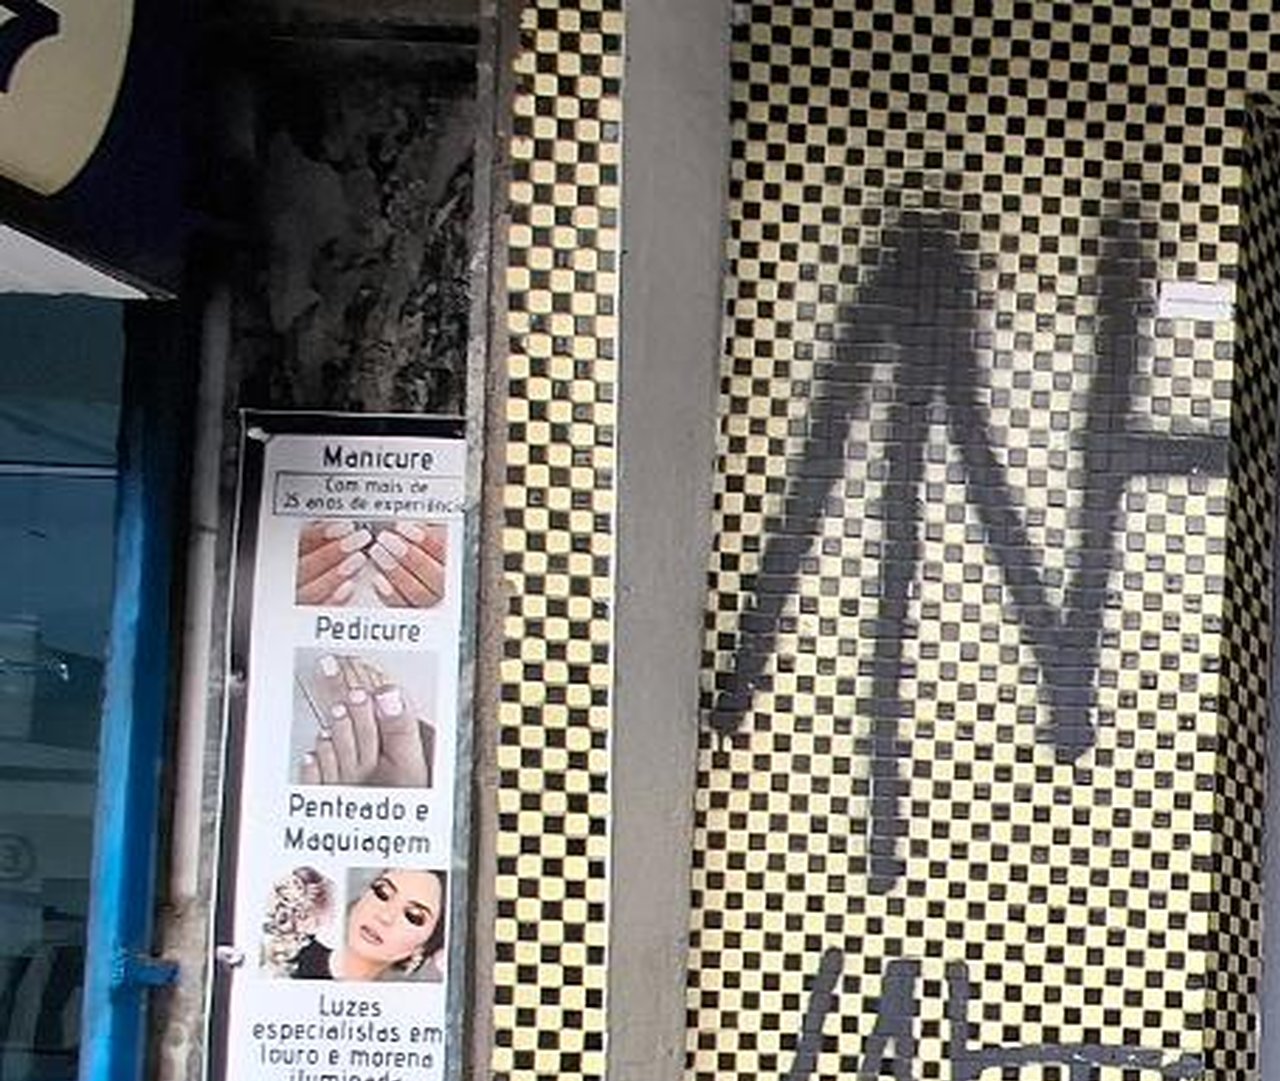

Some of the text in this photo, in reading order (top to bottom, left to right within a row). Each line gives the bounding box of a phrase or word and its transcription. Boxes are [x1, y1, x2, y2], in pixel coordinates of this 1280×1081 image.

[323, 445, 434, 470] Manicure
[325, 477, 428, 494] Com mais de
[306, 497, 344, 510] anos
[315, 616, 421, 643] Pedicure
[288, 793, 430, 822] Penteado e
[283, 826, 431, 859] Maquiagem
[318, 994, 382, 1017] Luzes
[252, 1021, 443, 1043] especialistas em
[260, 1044, 433, 1069] louro e morena
